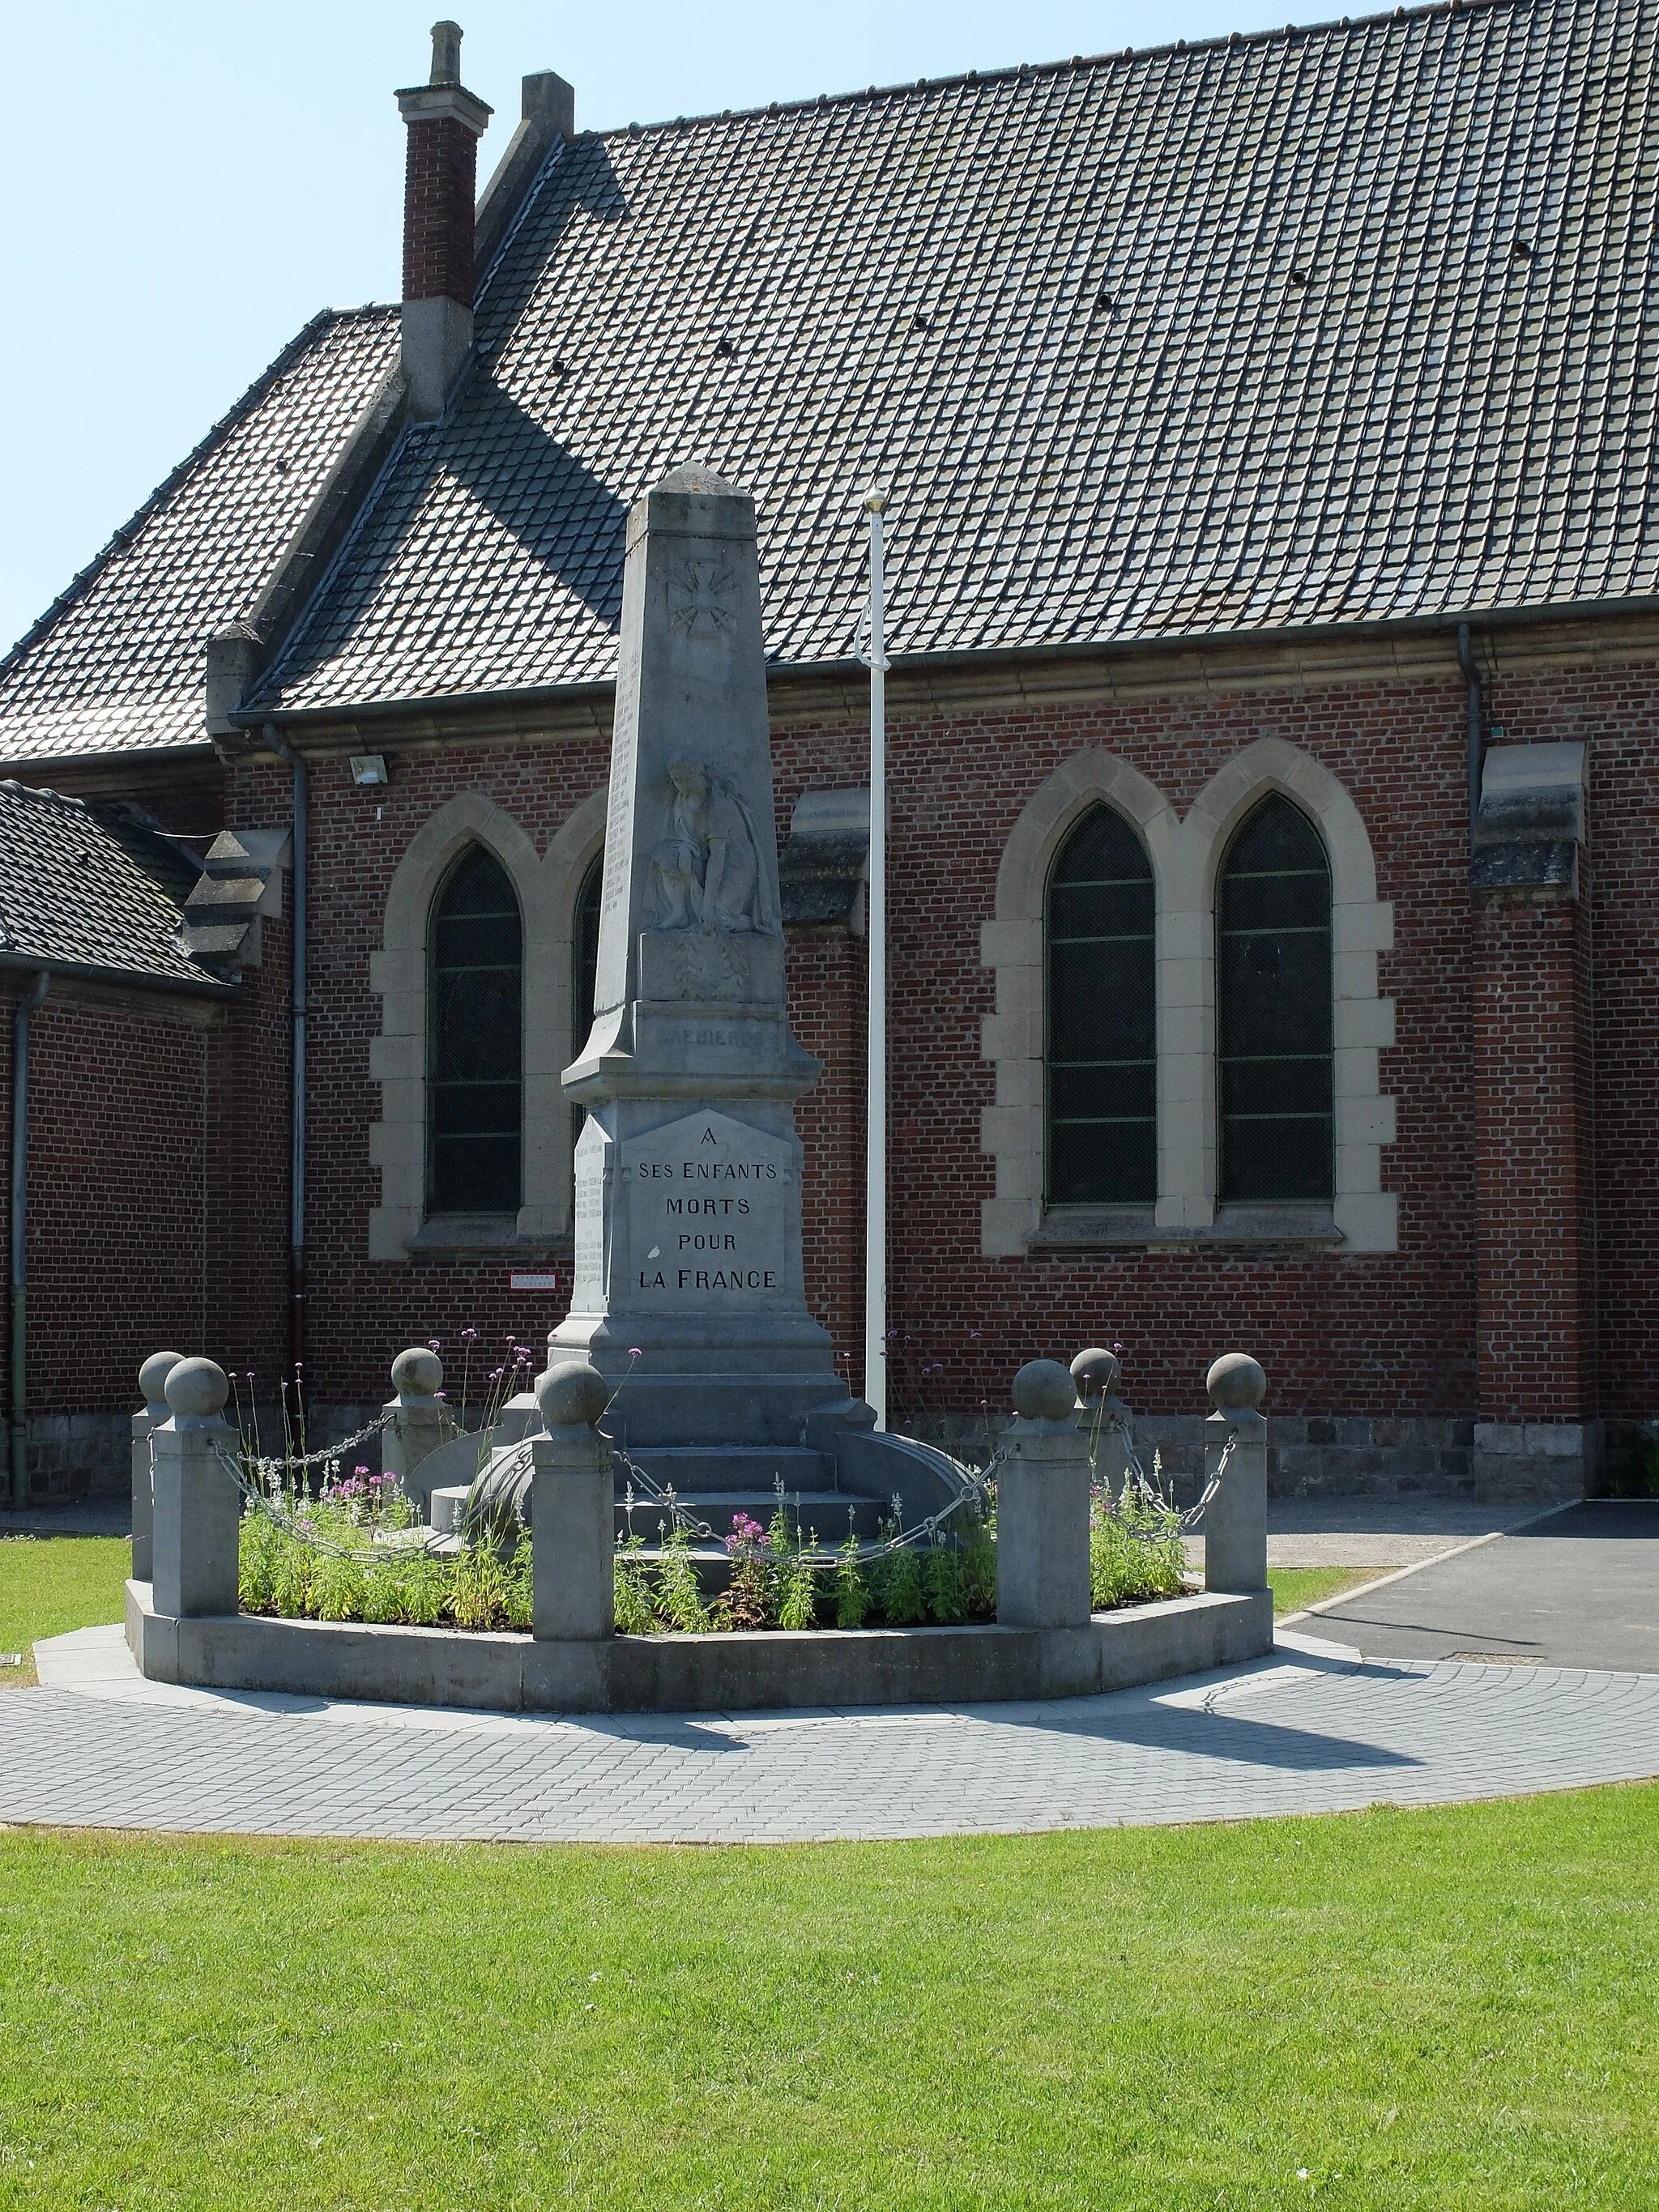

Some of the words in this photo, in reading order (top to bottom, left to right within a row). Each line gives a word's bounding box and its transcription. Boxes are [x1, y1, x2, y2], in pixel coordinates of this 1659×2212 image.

[701, 1127, 717, 1144] A
[639, 1162, 673, 1178] SES
[683, 1162, 777, 1179] ENFANTS
[667, 1198, 750, 1216] MORTS
[678, 1234, 736, 1251] POUR
[639, 1271, 666, 1289] LA
[677, 1269, 776, 1290] FRANCE
